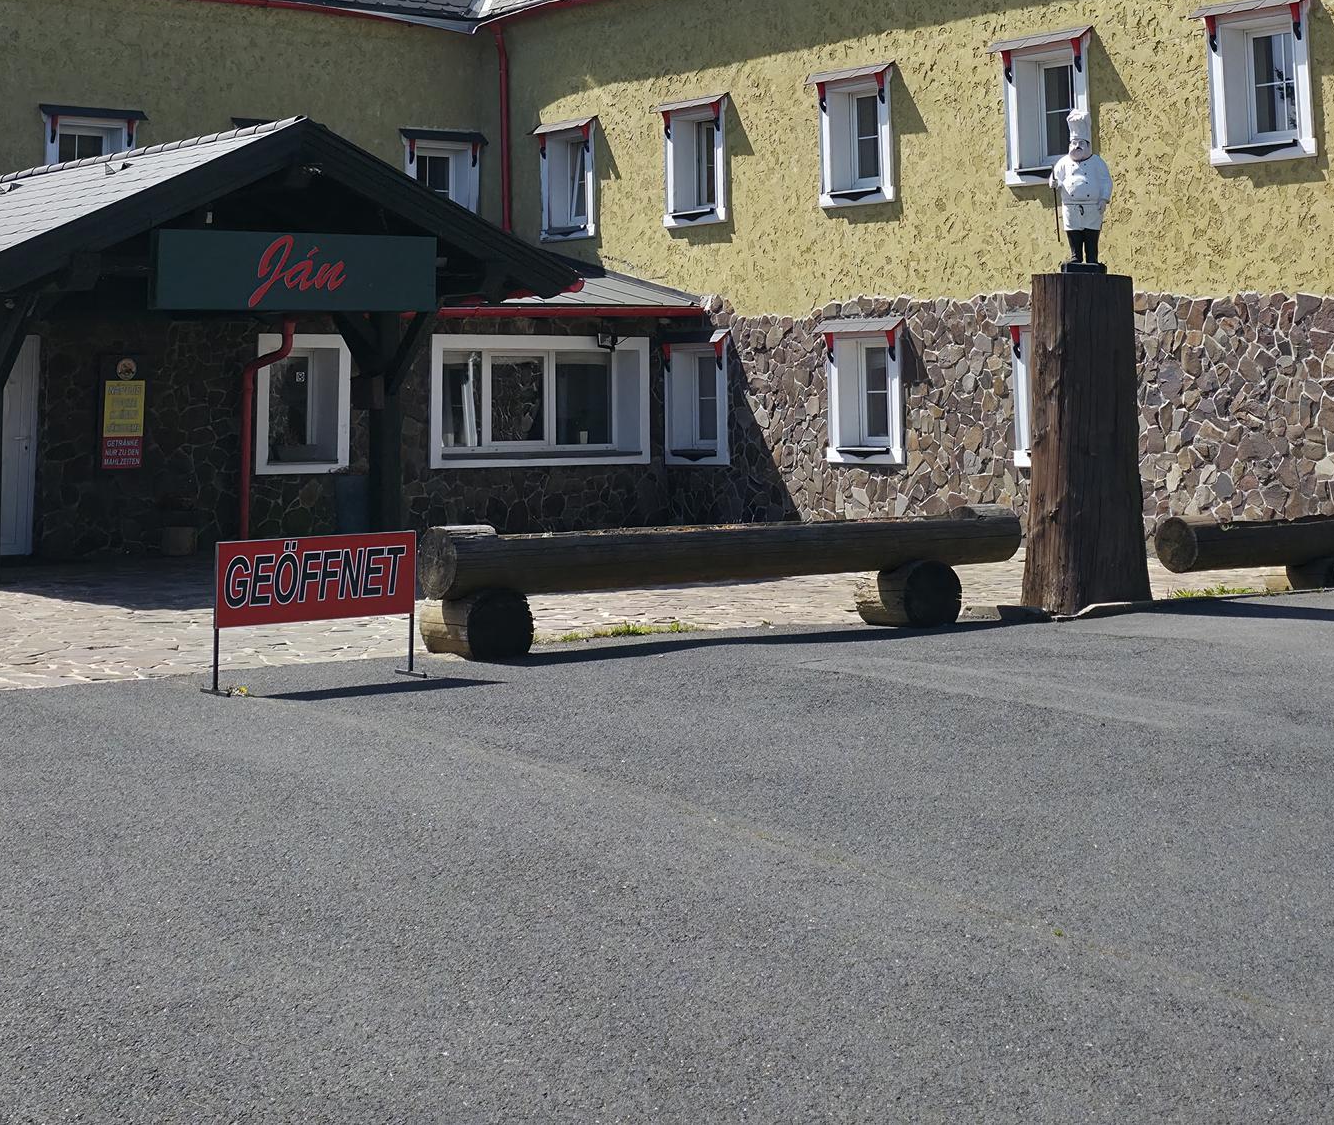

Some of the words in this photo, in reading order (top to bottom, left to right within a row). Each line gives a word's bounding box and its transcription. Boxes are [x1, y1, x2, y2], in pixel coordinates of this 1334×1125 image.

[248, 235, 347, 307] Ján
[105, 448, 117, 457] NUR
[224, 540, 407, 609] GEÖFFNET
